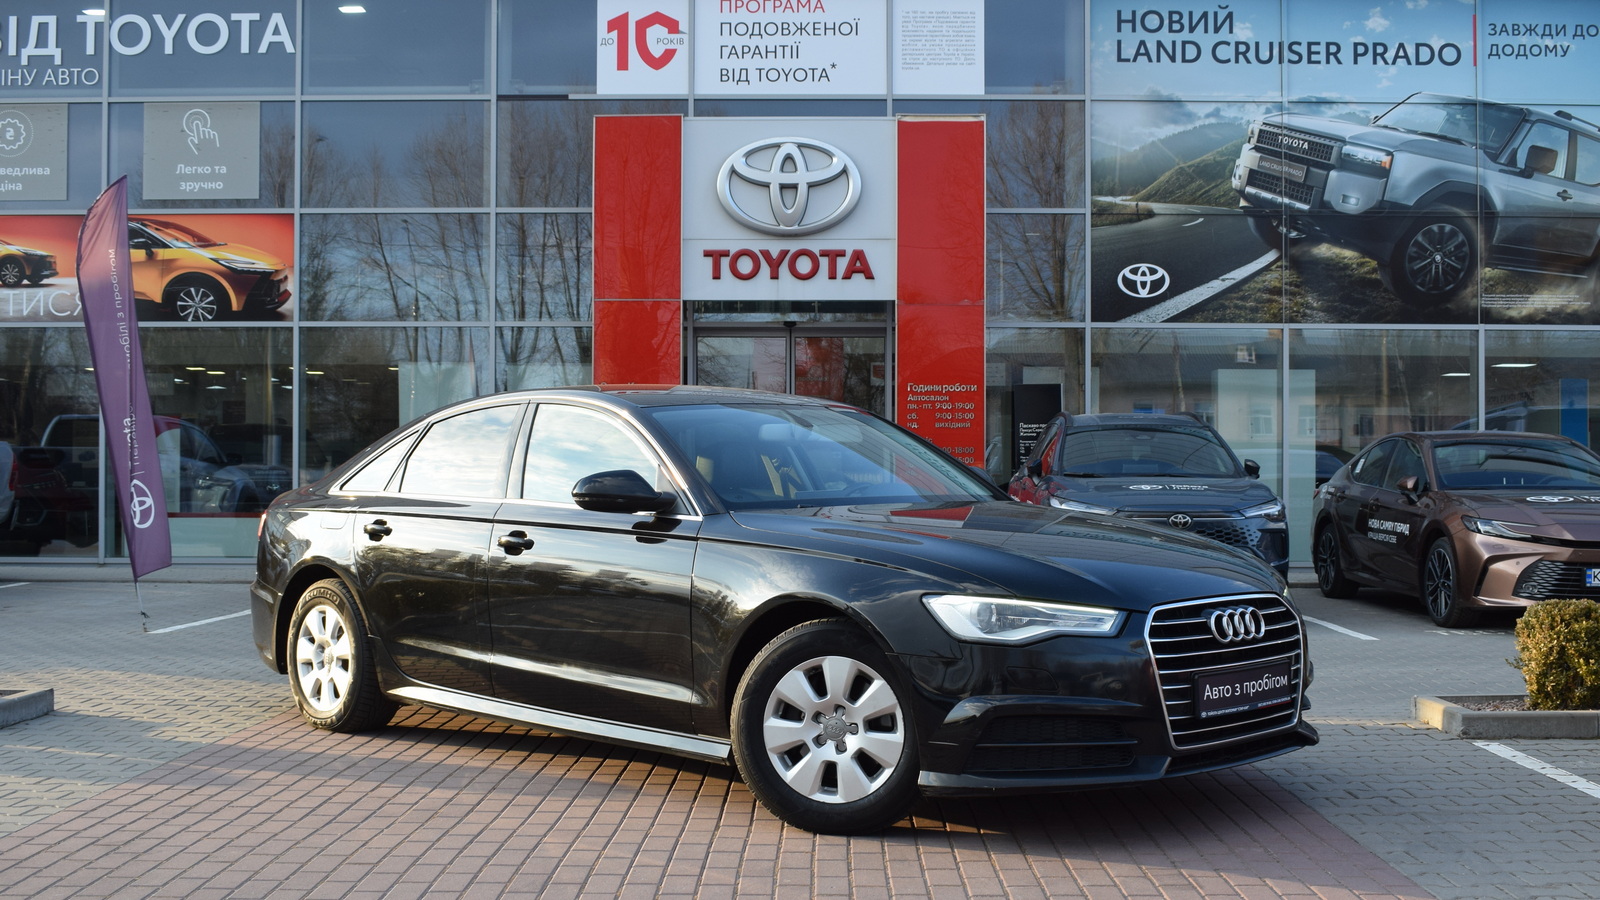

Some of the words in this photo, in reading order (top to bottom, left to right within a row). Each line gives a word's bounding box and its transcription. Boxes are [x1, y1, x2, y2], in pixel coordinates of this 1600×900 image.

[720, 0, 825, 14] ПРОГРАМА
[1116, 4, 1234, 34] НОВИЙ
[720, 18, 860, 39] ПОДОВЖЕНОЇ
[1488, 23, 1567, 40] ЗАВЖДИ
[0, 15, 62, 66] ІД
[76, 13, 296, 55] TOYOTA
[600, 37, 615, 47] ДО
[656, 37, 685, 46] РОКІВ
[720, 41, 801, 60] ГАРАНТІЇ
[1116, 40, 1202, 63] LAND
[1211, 40, 1343, 65] CRUISER
[1353, 42, 1462, 67] PRADO
[1488, 44, 1570, 60] ДОДОМУ
[42, 68, 99, 85] АВТО
[720, 68, 750, 85] ВІД
[1278, 135, 1309, 150] TOYOTA
[0, 167, 50, 177] ведлива
[176, 164, 211, 174] Легко
[214, 165, 227, 174] та
[179, 181, 224, 192] зручно
[703, 248, 875, 280] TOYOTA
[108, 248, 122, 308] пробігом
[117, 311, 125, 319] з
[907, 383, 941, 392] Години
[942, 383, 977, 393] роботи
[907, 393, 949, 401] Автосалон
[306, 589, 339, 604] KUMHO
[1203, 684, 1232, 700] Авто
[1243, 673, 1288, 696] пробігом
